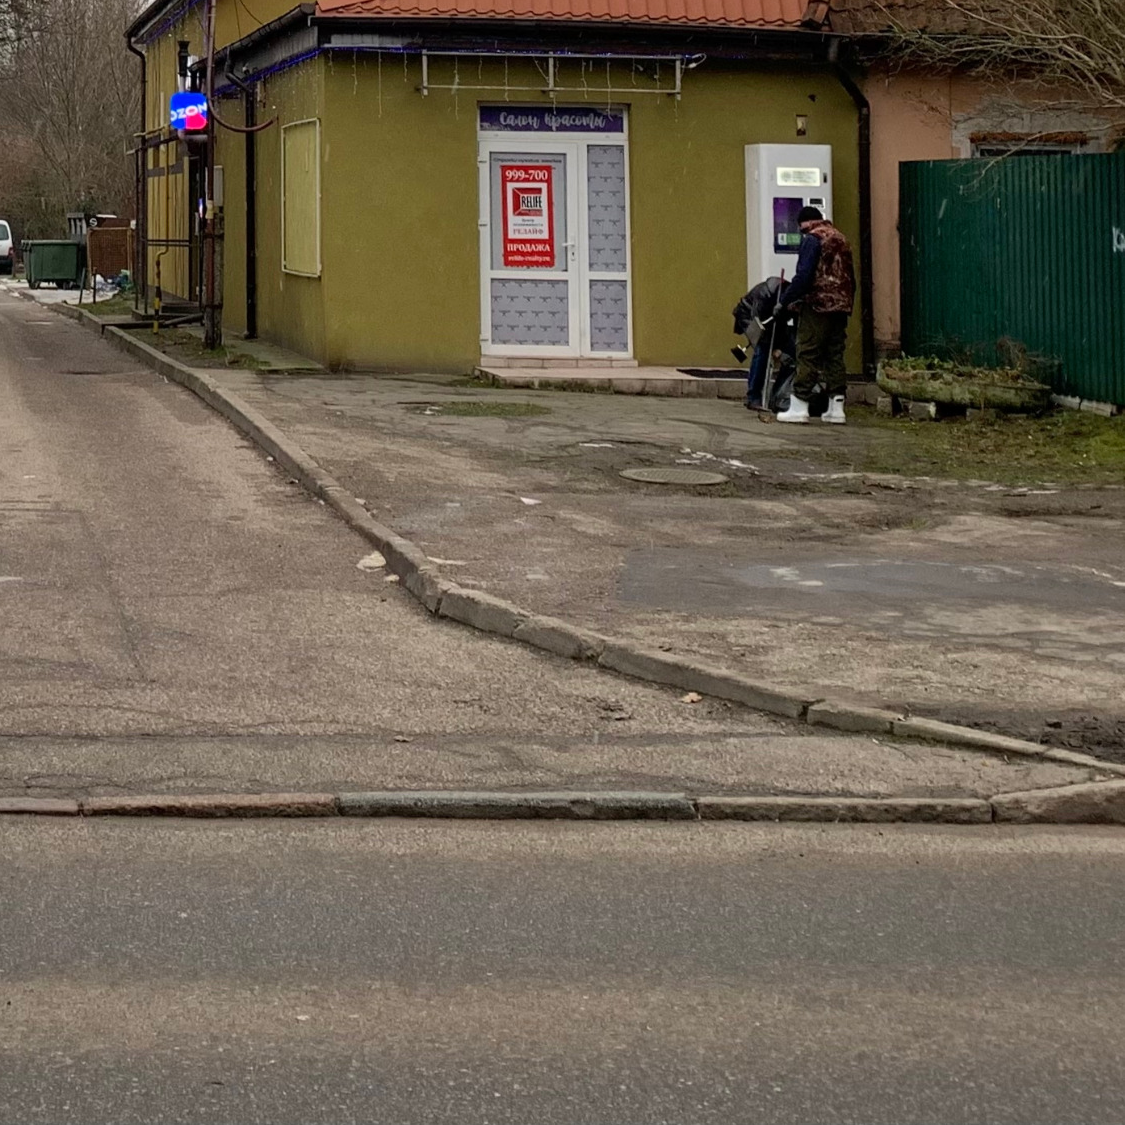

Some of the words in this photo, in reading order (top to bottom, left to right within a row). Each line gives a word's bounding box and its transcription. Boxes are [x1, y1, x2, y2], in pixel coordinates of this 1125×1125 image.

[170, 102, 207, 122] OZON
[499, 111, 540, 129] Салон
[505, 169, 548, 181] 999-700
[521, 195, 543, 209] RELIFE
[507, 243, 551, 253] ПРОДАЖА
